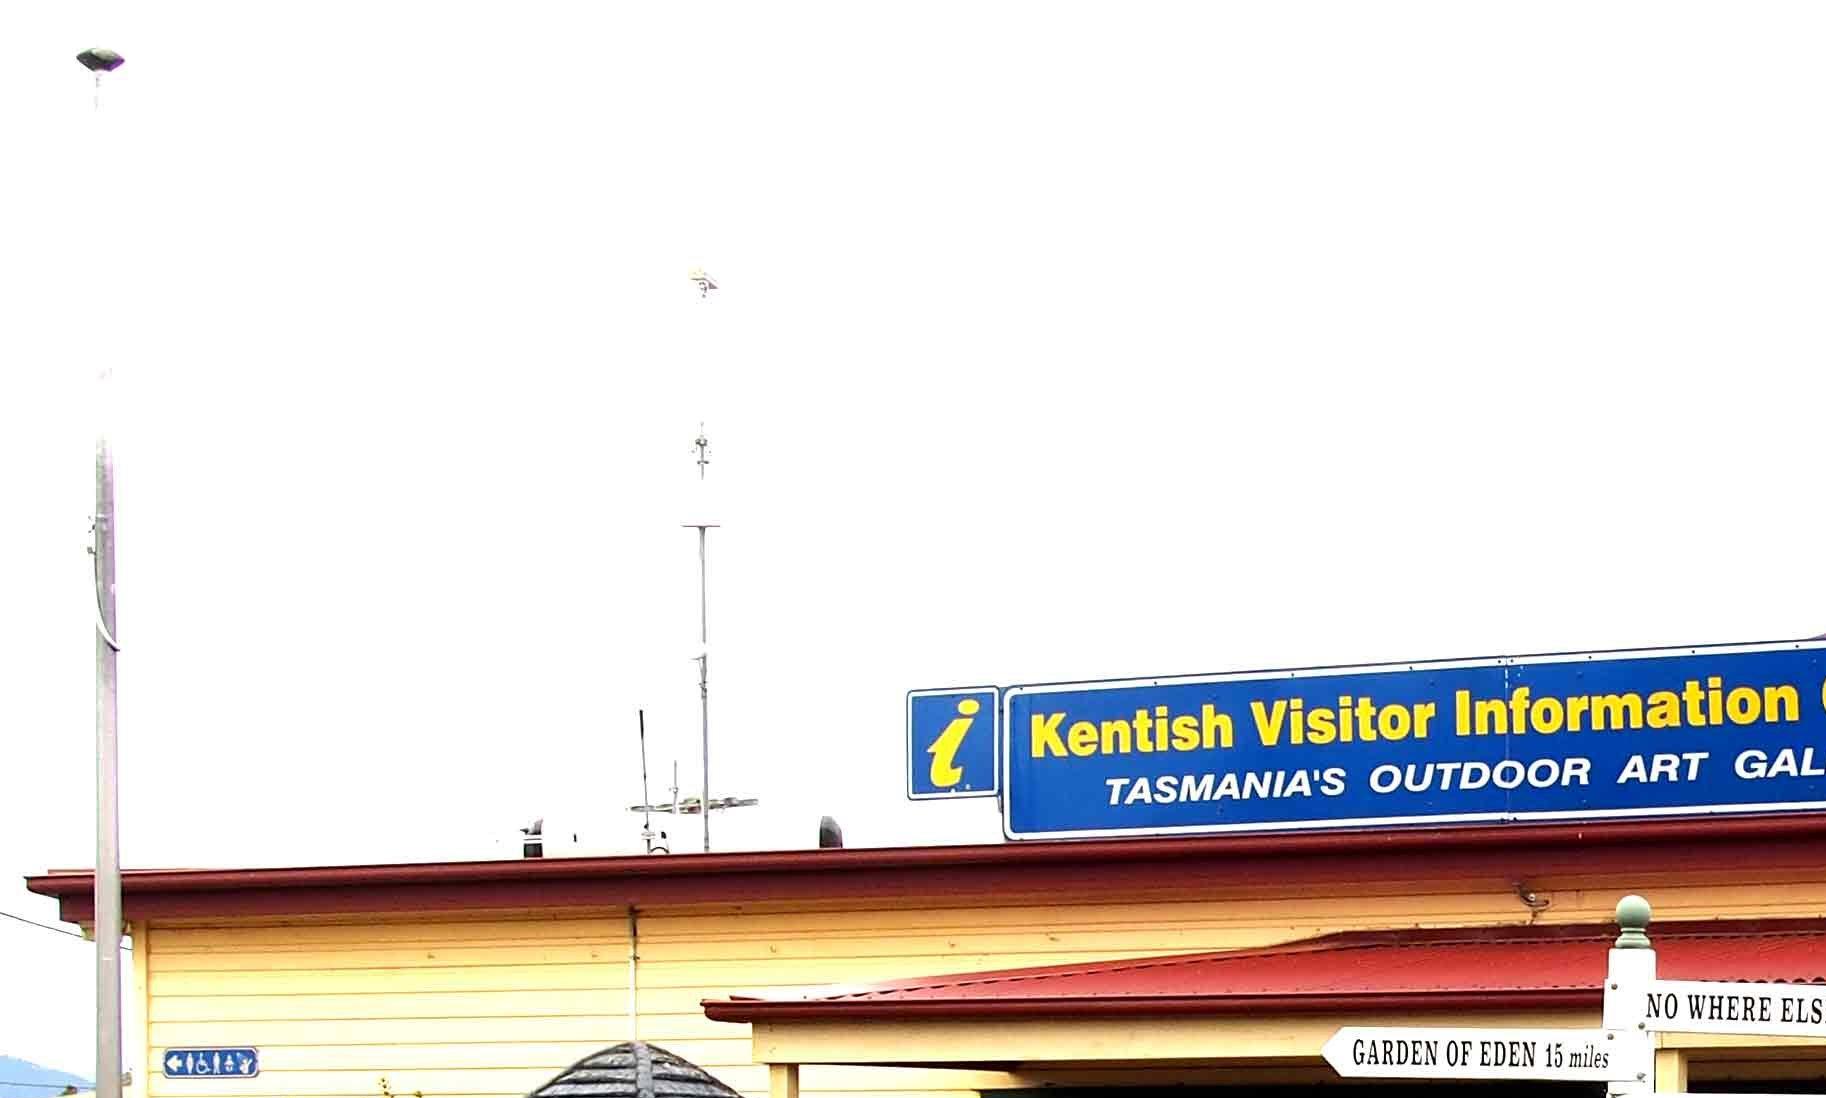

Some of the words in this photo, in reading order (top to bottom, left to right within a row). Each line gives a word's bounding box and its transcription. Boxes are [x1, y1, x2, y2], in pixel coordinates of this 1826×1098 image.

[1030, 706, 1234, 760] Kentish
[1252, 695, 1437, 746] Visitor
[1456, 675, 1806, 736] Information
[1104, 767, 1347, 806] TASMANIA'S
[1368, 755, 1592, 794] OUTDOOR
[1615, 752, 1709, 785] ART
[1645, 992, 1678, 1020] NO
[1687, 993, 1772, 1023] WHERE
[1352, 1038, 1438, 1067] GARDEN
[1446, 1040, 1474, 1067] OF
[1479, 1041, 1537, 1068] EDEN
[1544, 1043, 1564, 1069] 15
[1568, 1045, 1610, 1070] miles
